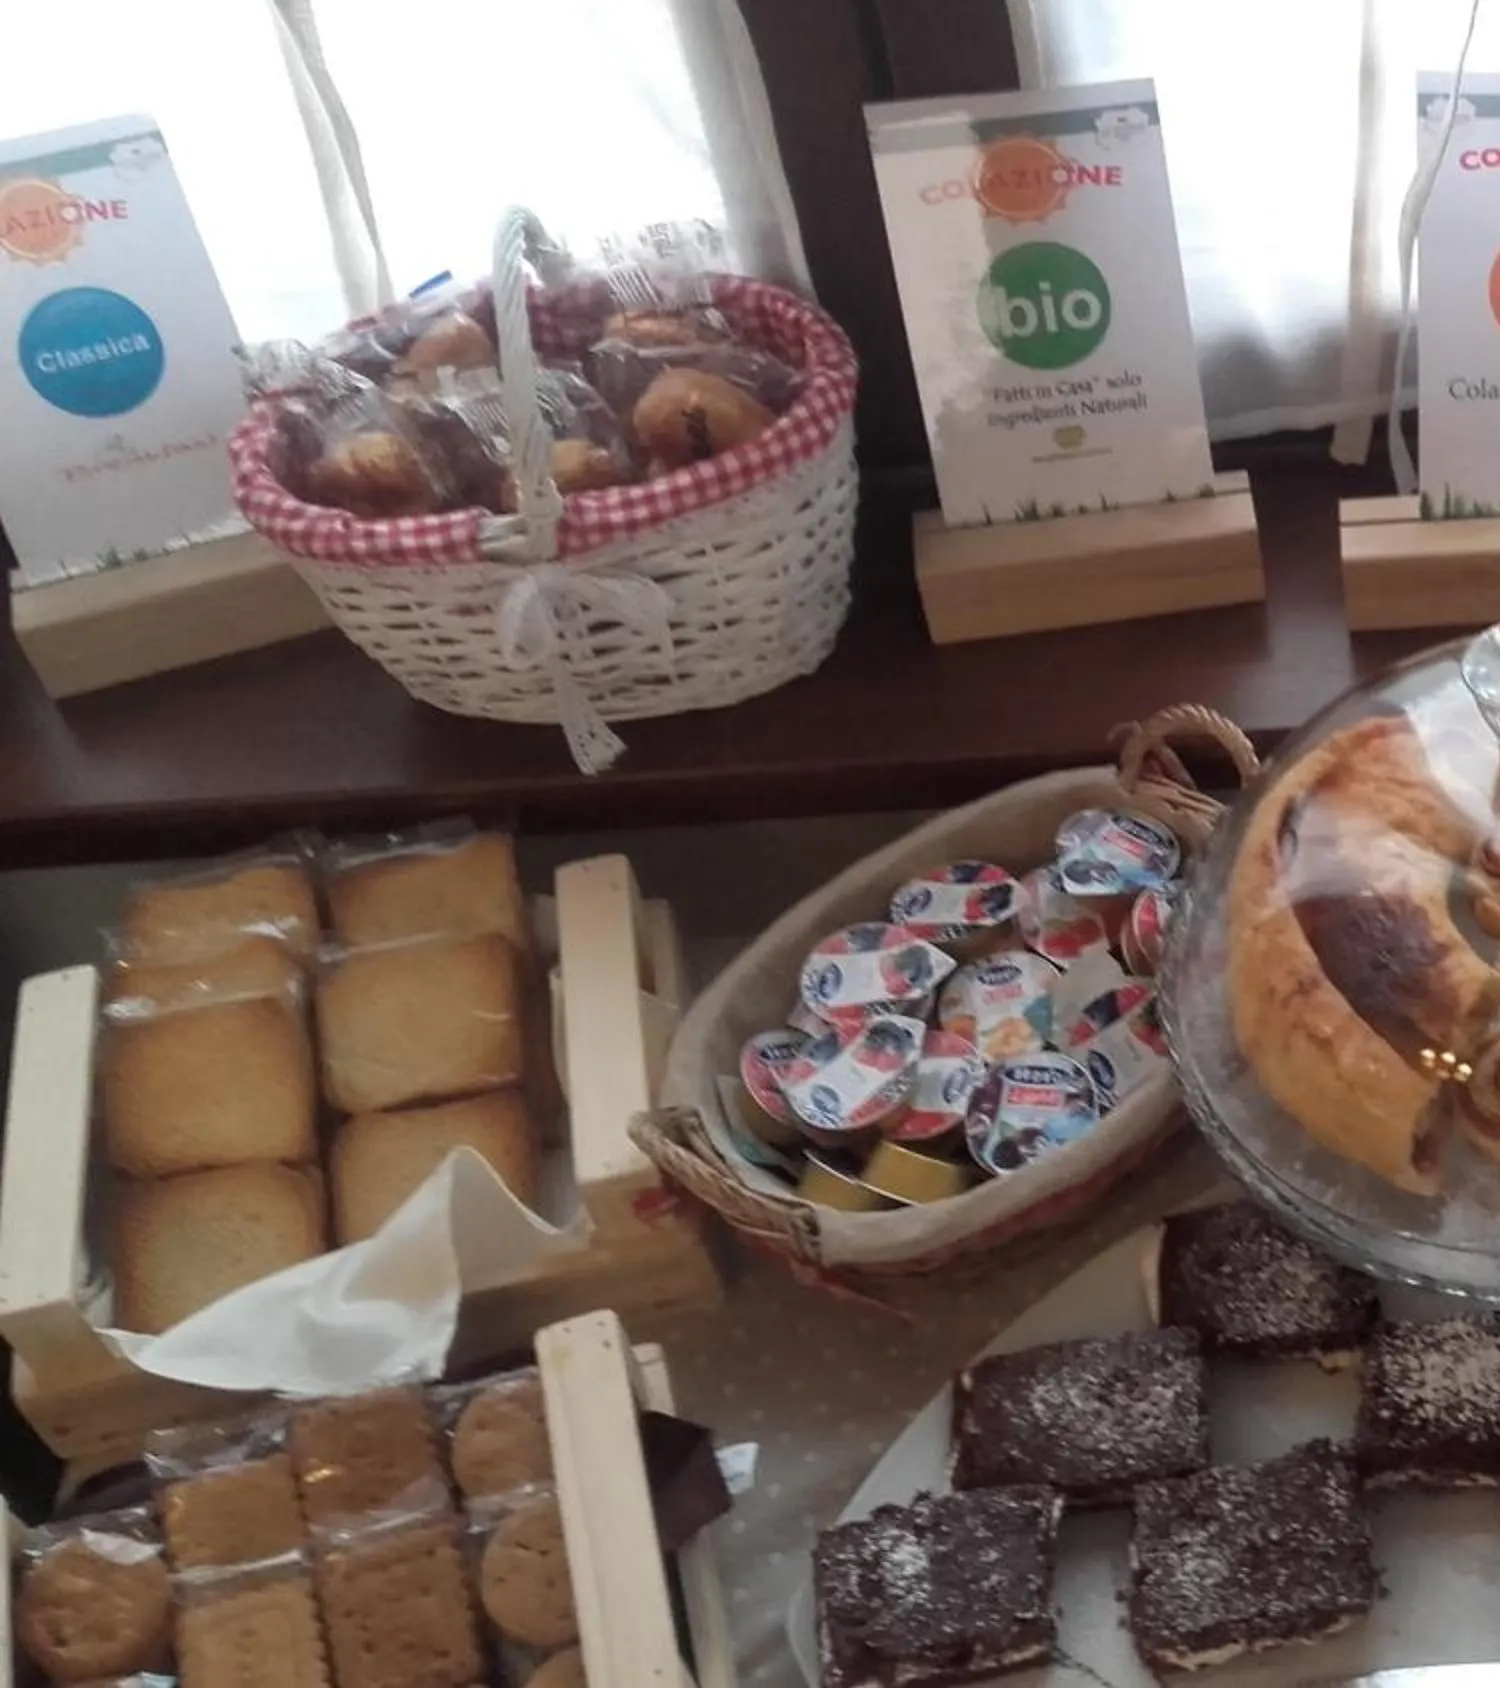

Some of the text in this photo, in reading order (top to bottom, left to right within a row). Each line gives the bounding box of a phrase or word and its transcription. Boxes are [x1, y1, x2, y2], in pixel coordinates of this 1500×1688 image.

[919, 163, 1122, 205] COLAZIONE
[0, 198, 128, 236] AZIONE
[993, 281, 1101, 339] bio
[37, 331, 151, 374] Classica
